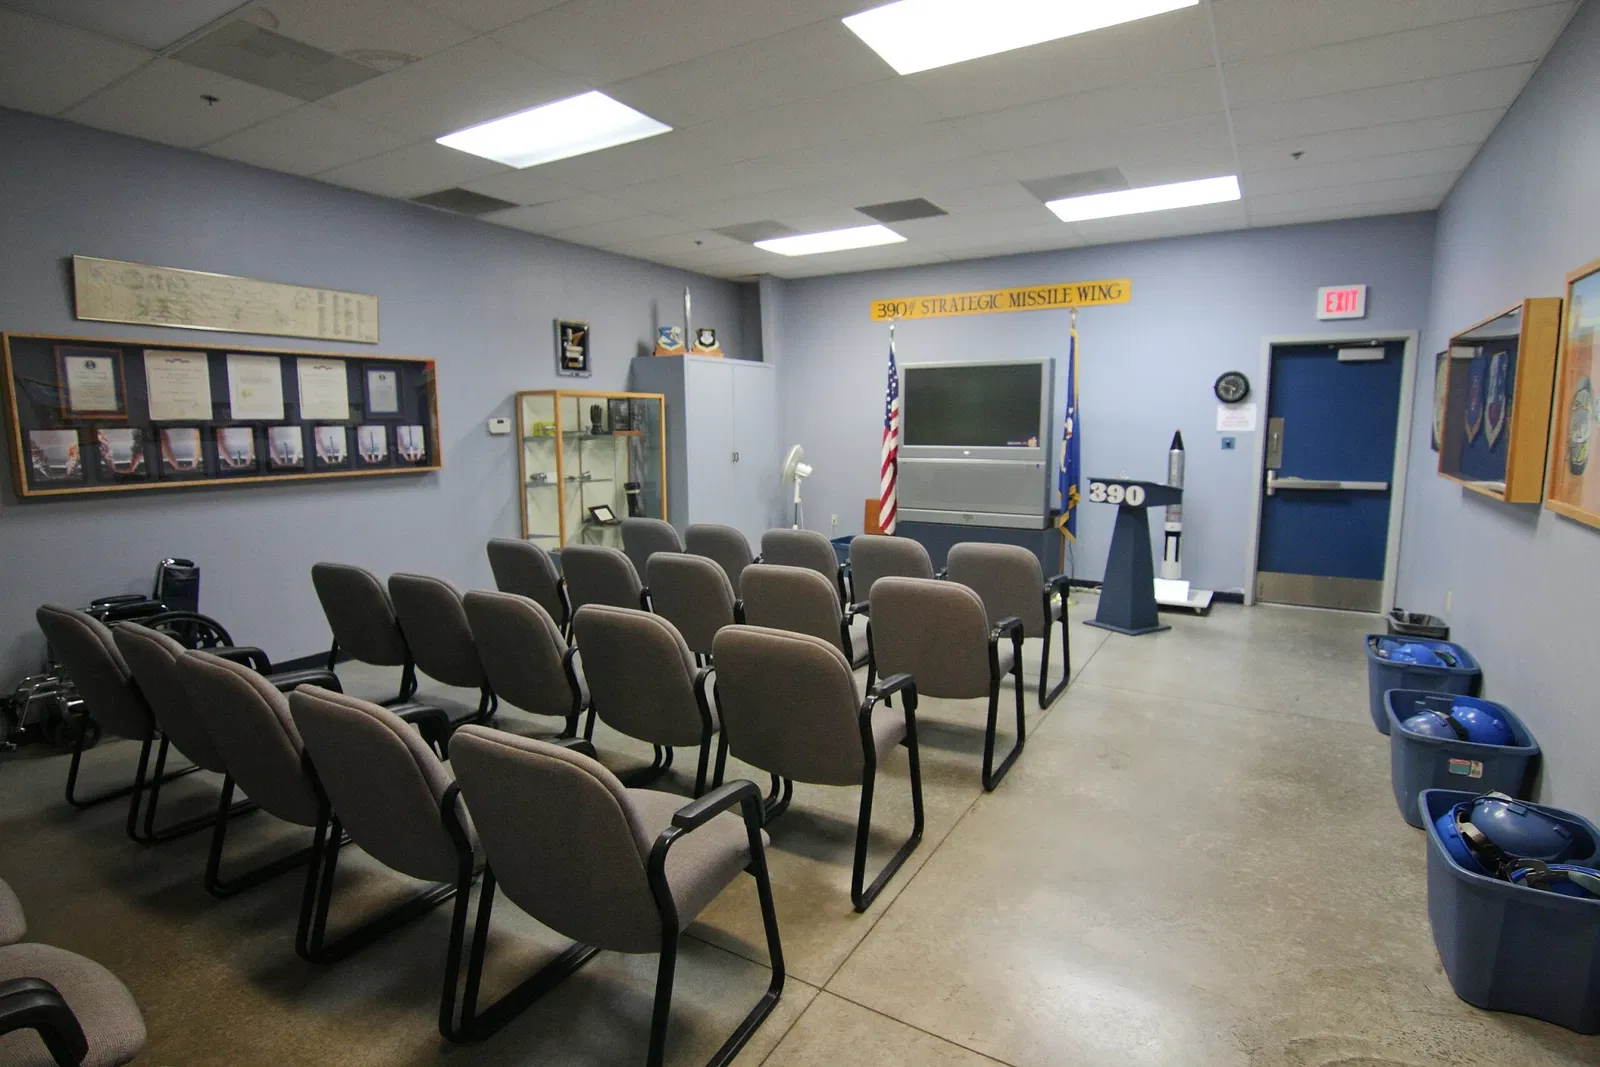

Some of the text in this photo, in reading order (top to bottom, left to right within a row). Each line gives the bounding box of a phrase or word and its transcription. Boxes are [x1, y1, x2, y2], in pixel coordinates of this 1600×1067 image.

[921, 293, 1004, 315] STRATEGIC
[1008, 287, 1073, 308] MISSILE
[1077, 283, 1122, 302] WING
[1325, 288, 1359, 313] EXIT
[1090, 482, 1145, 506] 390
